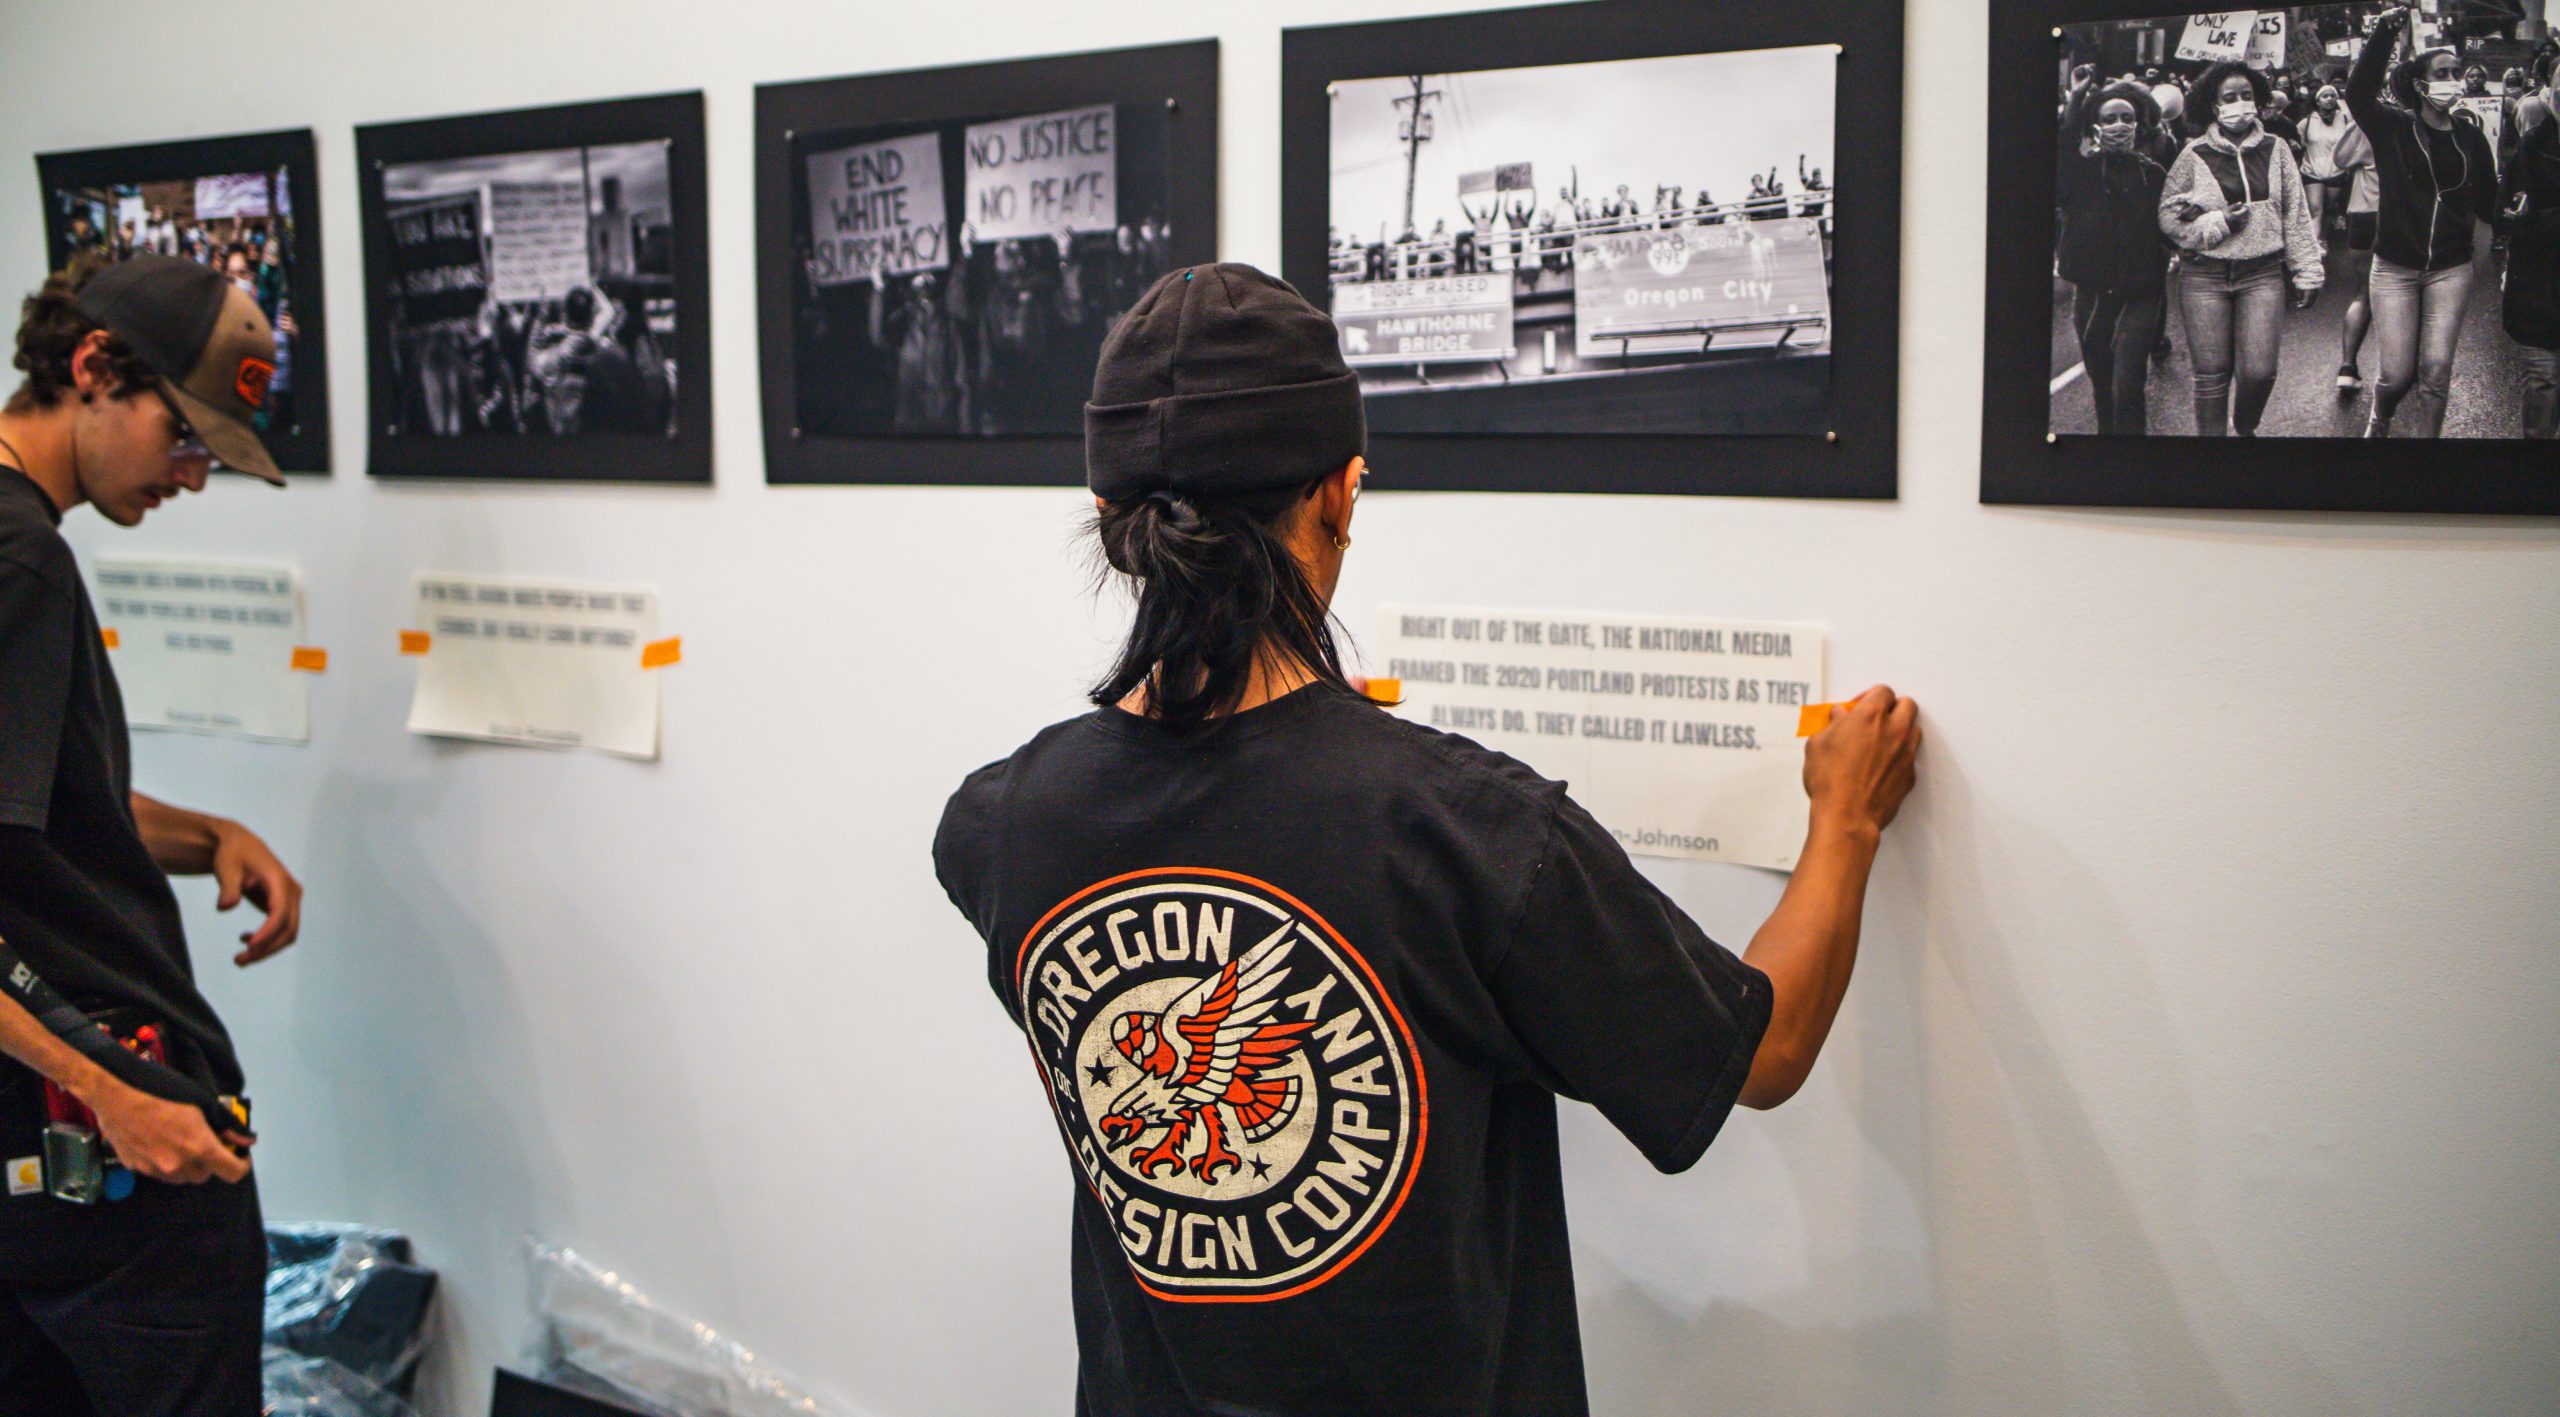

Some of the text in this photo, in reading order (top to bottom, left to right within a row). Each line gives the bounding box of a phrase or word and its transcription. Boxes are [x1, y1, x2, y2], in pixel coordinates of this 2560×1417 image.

[2194, 15, 2229, 28] ONLY
[2207, 30, 2238, 47] LOVE
[2259, 16, 2281, 35] IS
[2465, 37, 2485, 50] RIP
[970, 111, 1112, 169] NO JUSTICE
[846, 149, 904, 189] END
[830, 186, 910, 233] WHITE
[980, 171, 1104, 225] NO PEACE
[1369, 278, 1488, 298] RIDGE RAISED
[1623, 279, 1773, 309] Oregon City
[1376, 313, 1496, 336] HAWTHORNE
[1398, 333, 1473, 354] BRIDGE
[1401, 615, 1792, 657] RIGHT OUT OF THE GATE, THE NATIONAL MEDIA
[1389, 658, 1810, 706] FRAMED THE 2020 PORTLAND PROTESTS AS THEY
[1431, 704, 1762, 750] ALWAYS DO. THEY CALLED IT LAWLESS.
[1037, 901, 1235, 1048] OREGON
[1080, 973, 1392, 1271] DESIGN COMPANY
